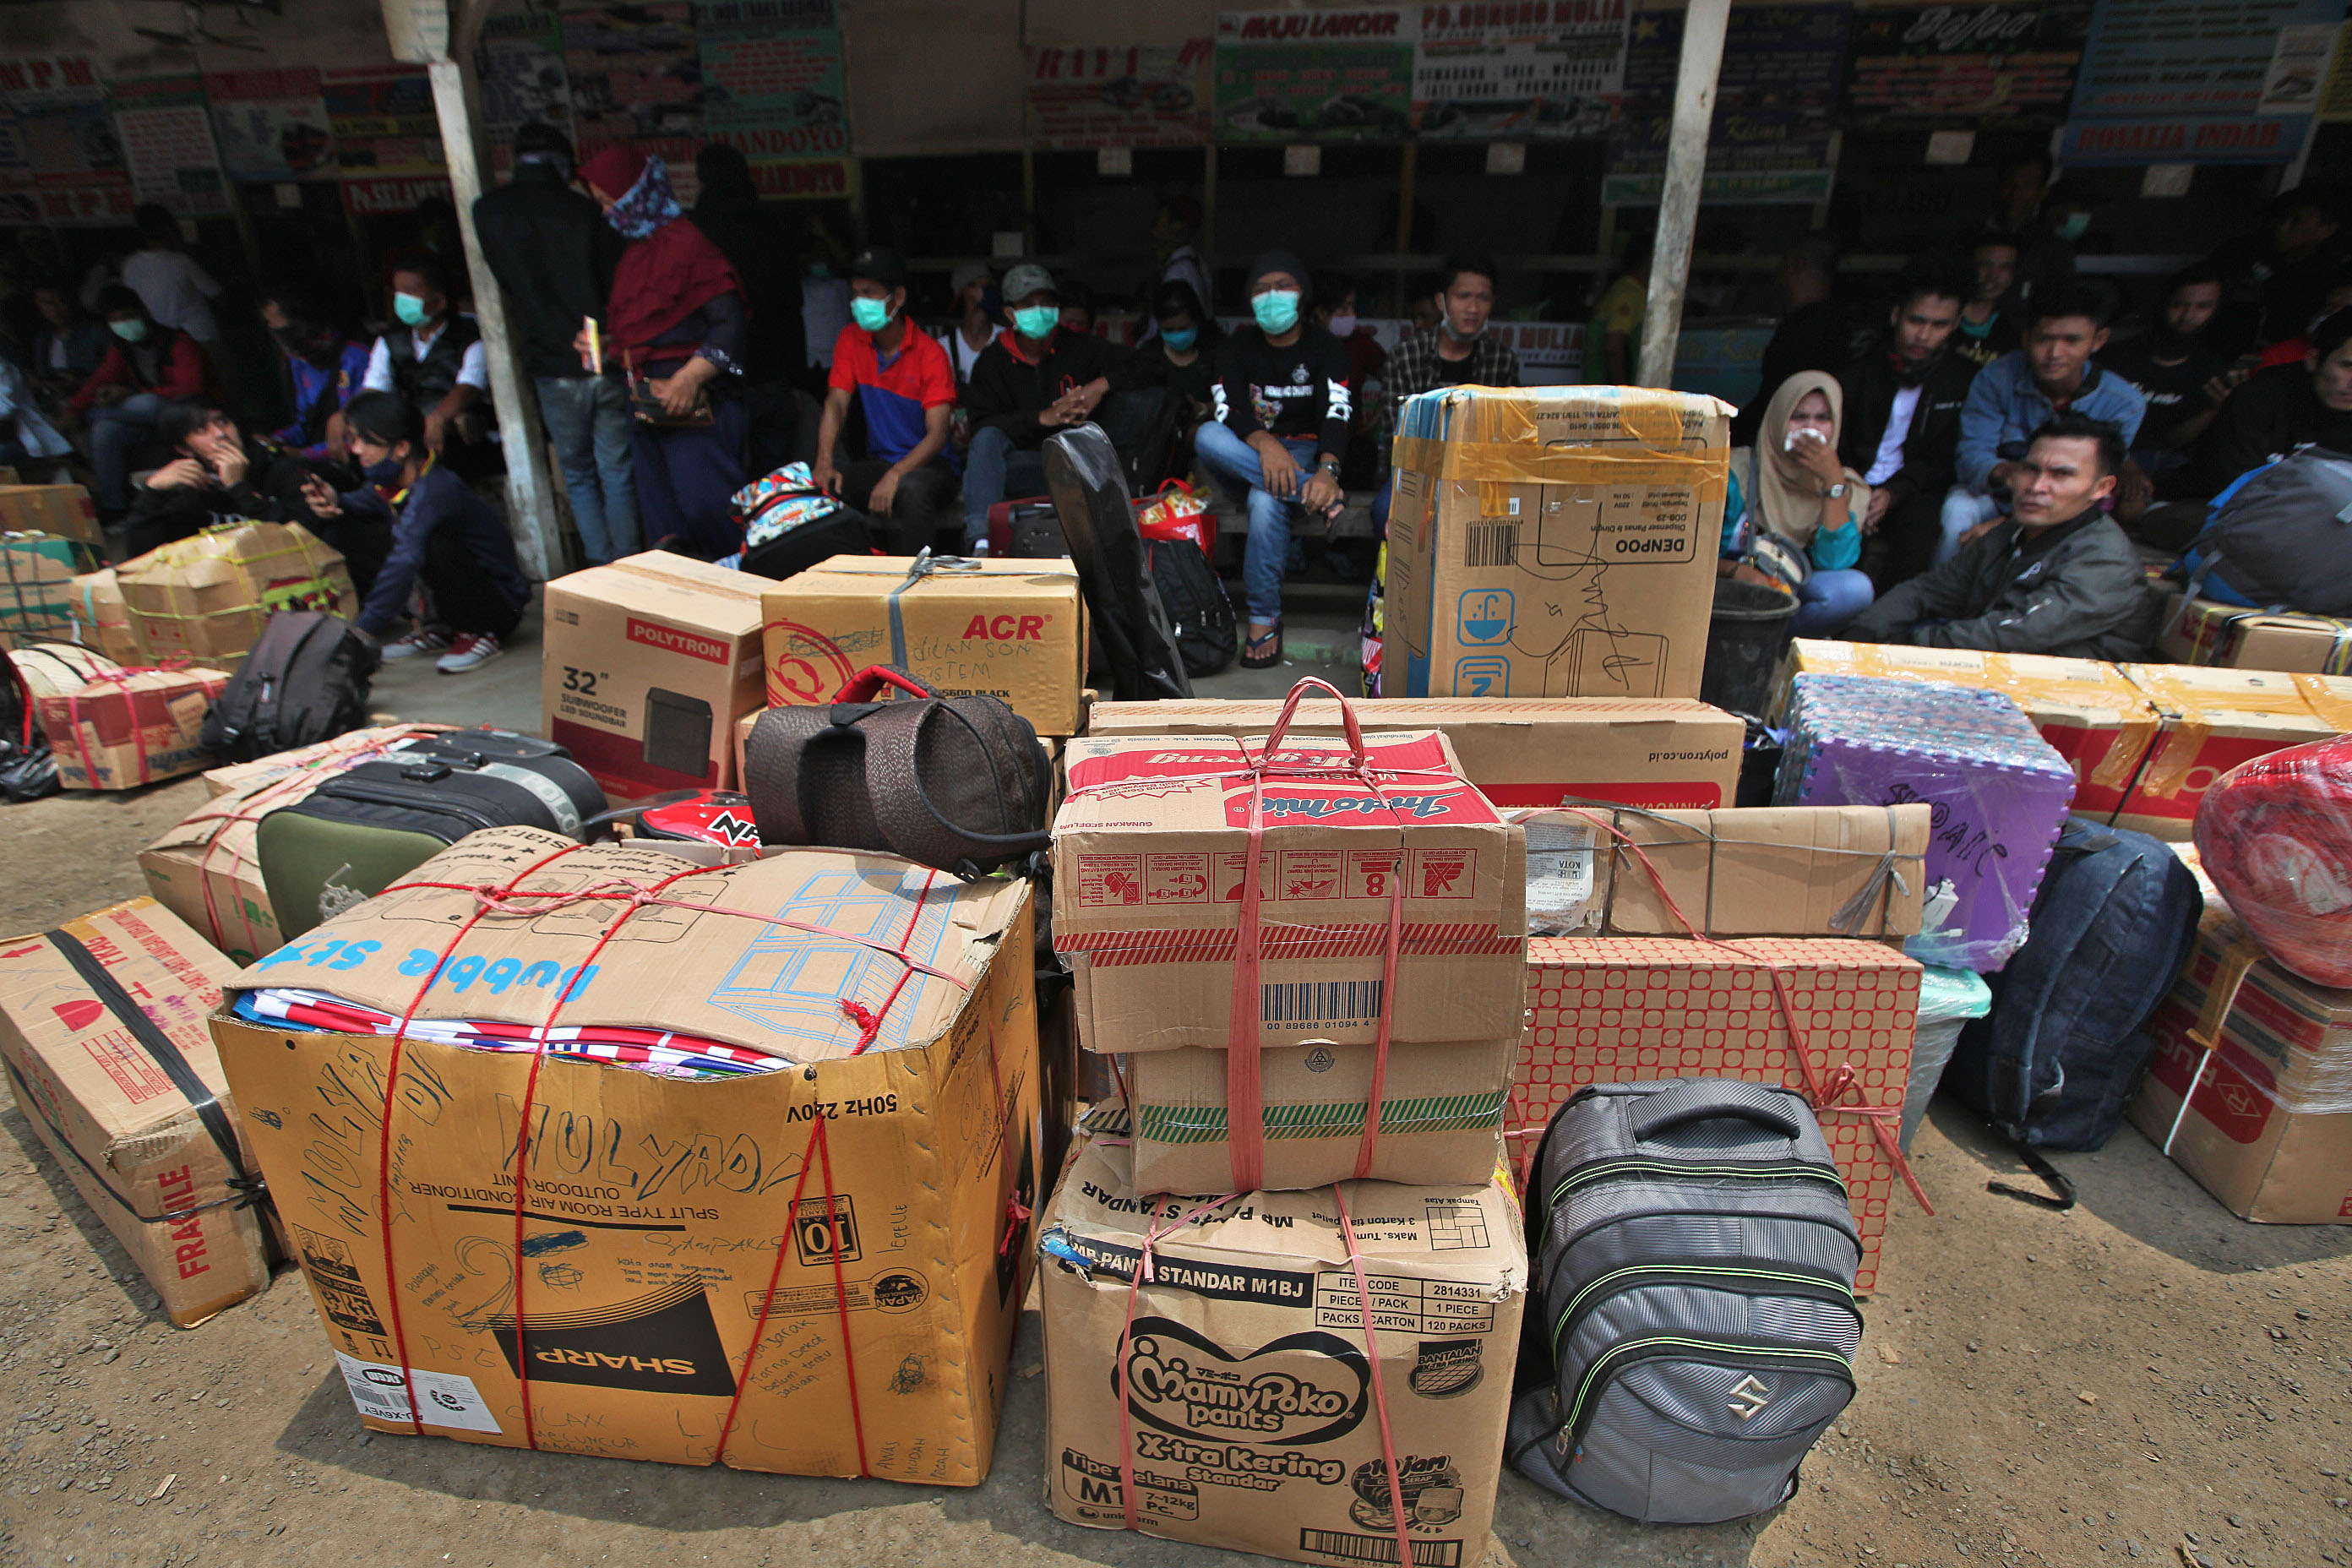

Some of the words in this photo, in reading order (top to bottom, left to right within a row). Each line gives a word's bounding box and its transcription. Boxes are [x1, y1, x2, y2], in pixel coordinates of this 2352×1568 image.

[2077, 123, 2187, 150] ROSALIA
[2195, 121, 2284, 148] INDAH
[1614, 538, 1685, 553] DENPOO
[962, 614, 1043, 640] ACR
[634, 624, 722, 659] POLYTRON
[560, 693, 628, 719] SUBWOOFER
[560, 703, 577, 715] LED
[577, 706, 627, 728] SOUNDBAR
[1648, 749, 1729, 763] polytron.co.id
[1059, 821, 1105, 830] SEBELUM
[1558, 859, 1582, 871] KOTA
[1365, 873, 1386, 897] 8
[400, 949, 601, 1004] Bubble
[1266, 1022, 1281, 1031] 00
[1285, 1021, 1320, 1031] 89686
[1325, 1020, 1358, 1029] 01094
[844, 1093, 898, 1117] 50Hz
[533, 1178, 621, 1201] OUTDOOR
[529, 1194, 558, 1211] AIR
[558, 1200, 612, 1217] ROOM
[1081, 1180, 1182, 1221] STANDAR
[1424, 1196, 1446, 1206] Atas
[1446, 1197, 1481, 1206] Tampak
[617, 1205, 666, 1219] TYPE
[672, 1206, 720, 1221] SPLIT
[1310, 1211, 1342, 1226] pallet
[157, 1164, 211, 1280] FRAGILE
[1365, 1217, 1407, 1227] Karton
[1408, 1217, 1417, 1227] 3
[805, 1220, 851, 1253] 10
[1383, 1231, 1418, 1242] Maks.
[1158, 1265, 1246, 1293] STANDAR
[1250, 1277, 1304, 1298] M1BJ
[1368, 1279, 1400, 1291] CODE
[874, 1288, 922, 1298] TECHNOLOGY
[1434, 1284, 1482, 1299] 2814331
[875, 1292, 923, 1309] JAPAN
[1378, 1298, 1409, 1309] PACK
[1435, 1304, 1442, 1314] 1
[1446, 1304, 1479, 1315] PIECE
[1322, 1312, 1360, 1325] PACKS
[1369, 1315, 1416, 1328] CARTON
[1428, 1321, 1446, 1331] 120
[1449, 1320, 1487, 1331] PACKS
[535, 1348, 697, 1376] SHARP
[1418, 1344, 1484, 1364] BANTALAN
[1128, 1345, 1346, 1415] MamyPoko
[1187, 1402, 1285, 1433] pants
[1137, 1432, 1224, 1468] X-tra
[1226, 1446, 1345, 1485] Kering
[1398, 1454, 1451, 1479] jam
[1067, 1449, 1113, 1478] Tipe
[1119, 1469, 1193, 1492] elana
[1184, 1465, 1281, 1493] Standar
[1405, 1475, 1433, 1484] SERAP
[1145, 1500, 1175, 1516] PC.
